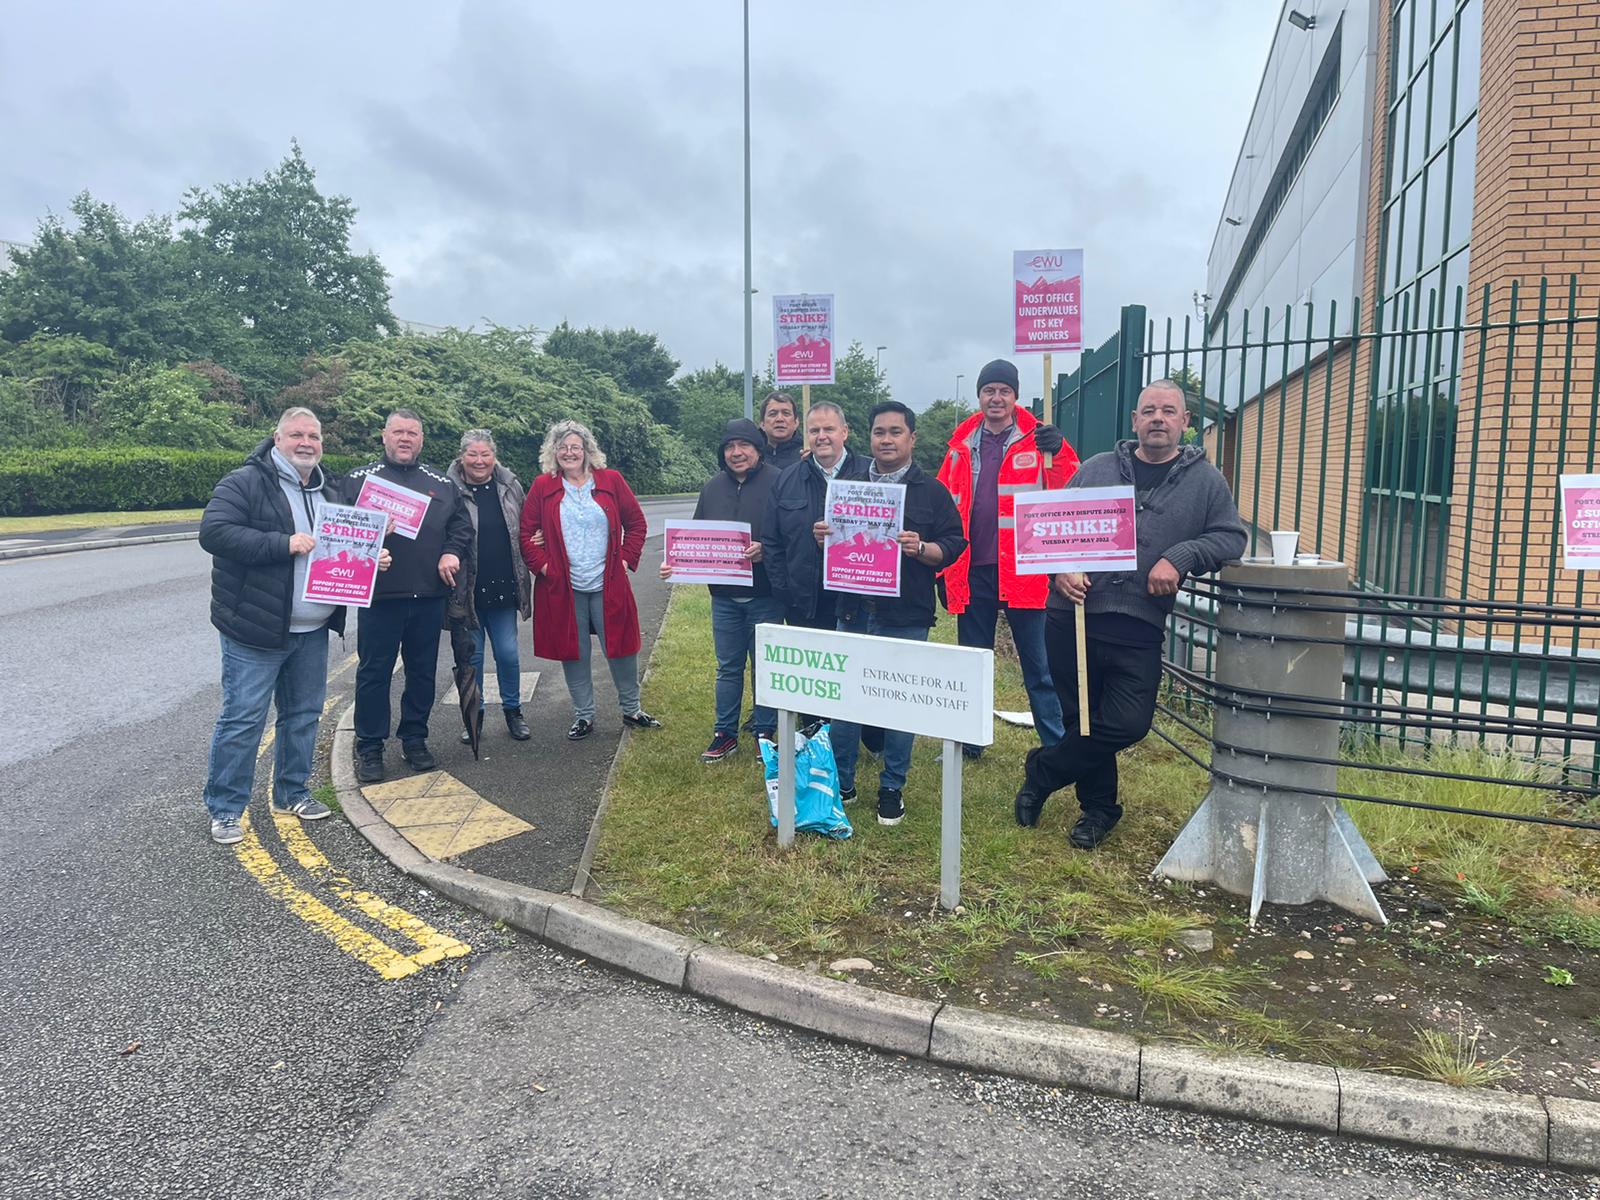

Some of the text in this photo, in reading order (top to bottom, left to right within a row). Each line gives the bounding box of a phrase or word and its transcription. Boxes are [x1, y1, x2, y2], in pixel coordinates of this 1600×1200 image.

[1030, 256, 1063, 268] CWU
[1023, 293, 1074, 303] POST OFFICE
[1019, 305, 1078, 316] UNDERVALUES
[780, 313, 827, 323] STRIKE!
[1034, 318, 1064, 328] ITS KEY
[1028, 330, 1069, 340] WORKERS
[794, 350, 814, 358] CWU
[368, 494, 417, 517] STRIKE!
[833, 503, 896, 518] STRIKE!
[1577, 509, 1582, 518] I
[322, 523, 379, 540] STRIKE!
[1032, 518, 1118, 537] STRIKE!
[848, 552, 875, 563] CWU
[330, 567, 354, 577] CWU
[764, 644, 848, 673] MIDWAY
[863, 668, 967, 692] ENTRANCE FOR ALL
[770, 672, 841, 700] HOUSE
[861, 685, 969, 711] VISITORS AND STAFF
